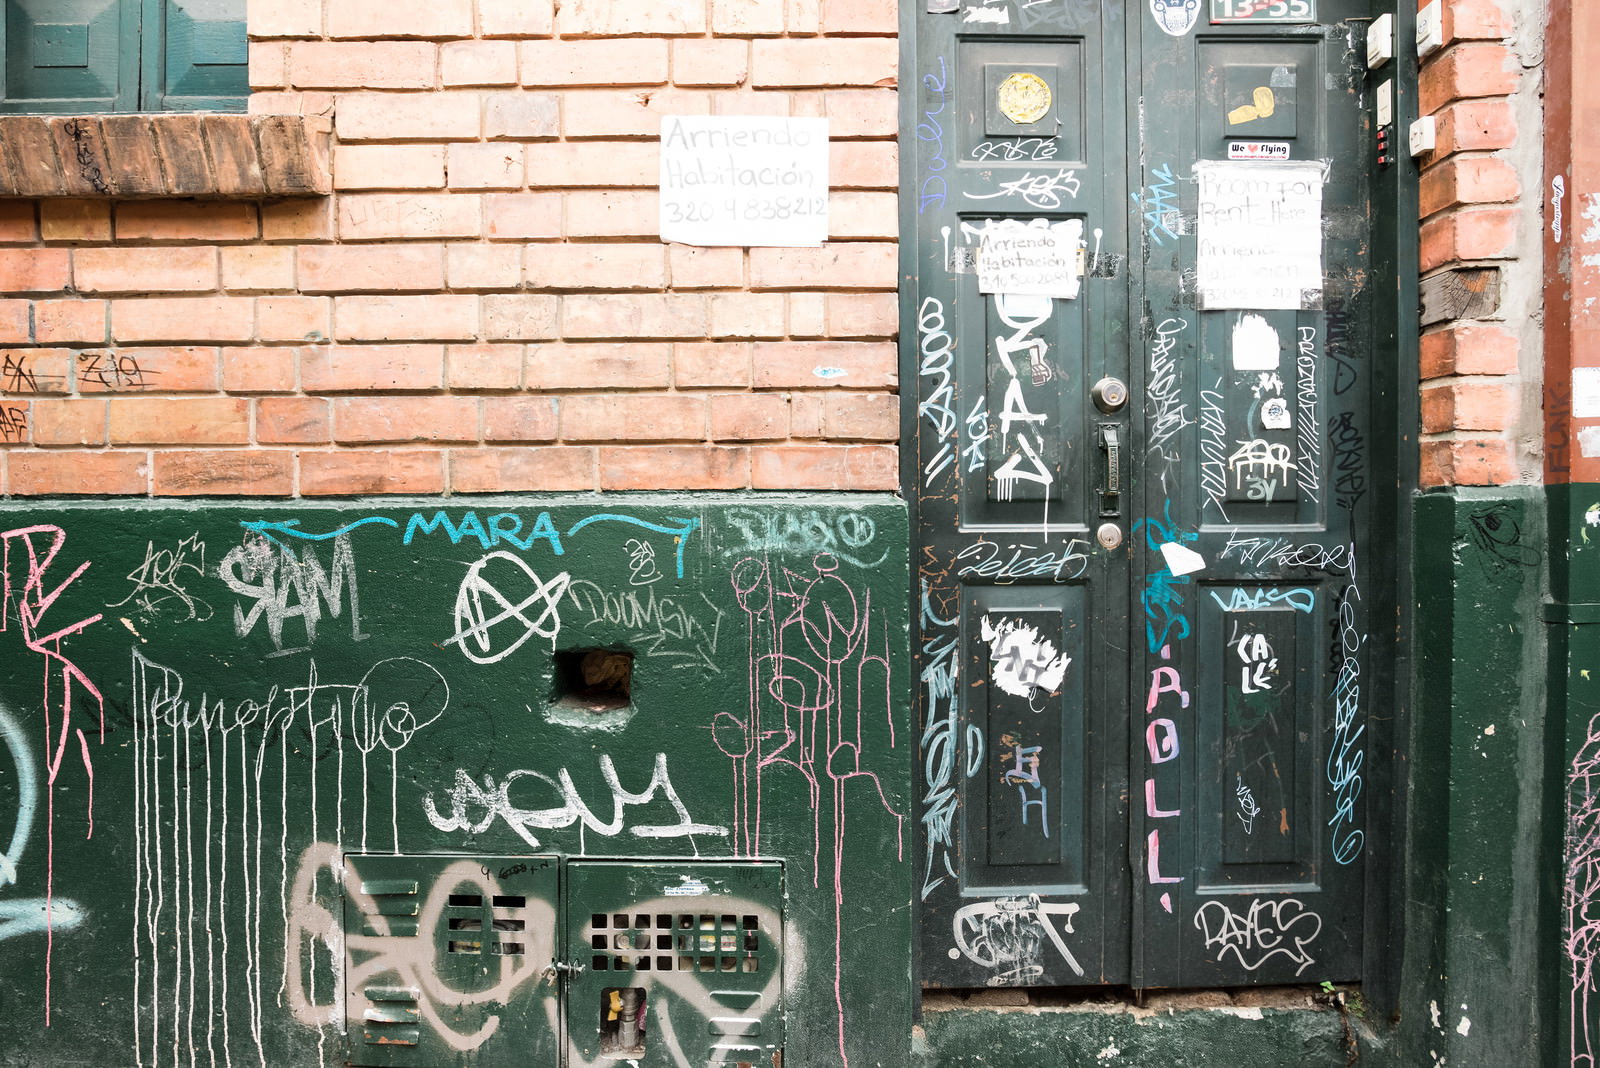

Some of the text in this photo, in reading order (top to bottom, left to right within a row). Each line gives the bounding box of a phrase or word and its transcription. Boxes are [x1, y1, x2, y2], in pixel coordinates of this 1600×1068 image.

[666, 118, 811, 150] Arriendo
[1231, 143, 1245, 152] We
[666, 154, 814, 189] Habitación
[1203, 171, 1270, 197] Room
[1199, 195, 1262, 227] Rent
[980, 233, 1056, 254] Arriendo
[982, 250, 1066, 273] Habitación
[1549, 388, 1570, 472] FUNK
[403, 510, 565, 556] MARA
